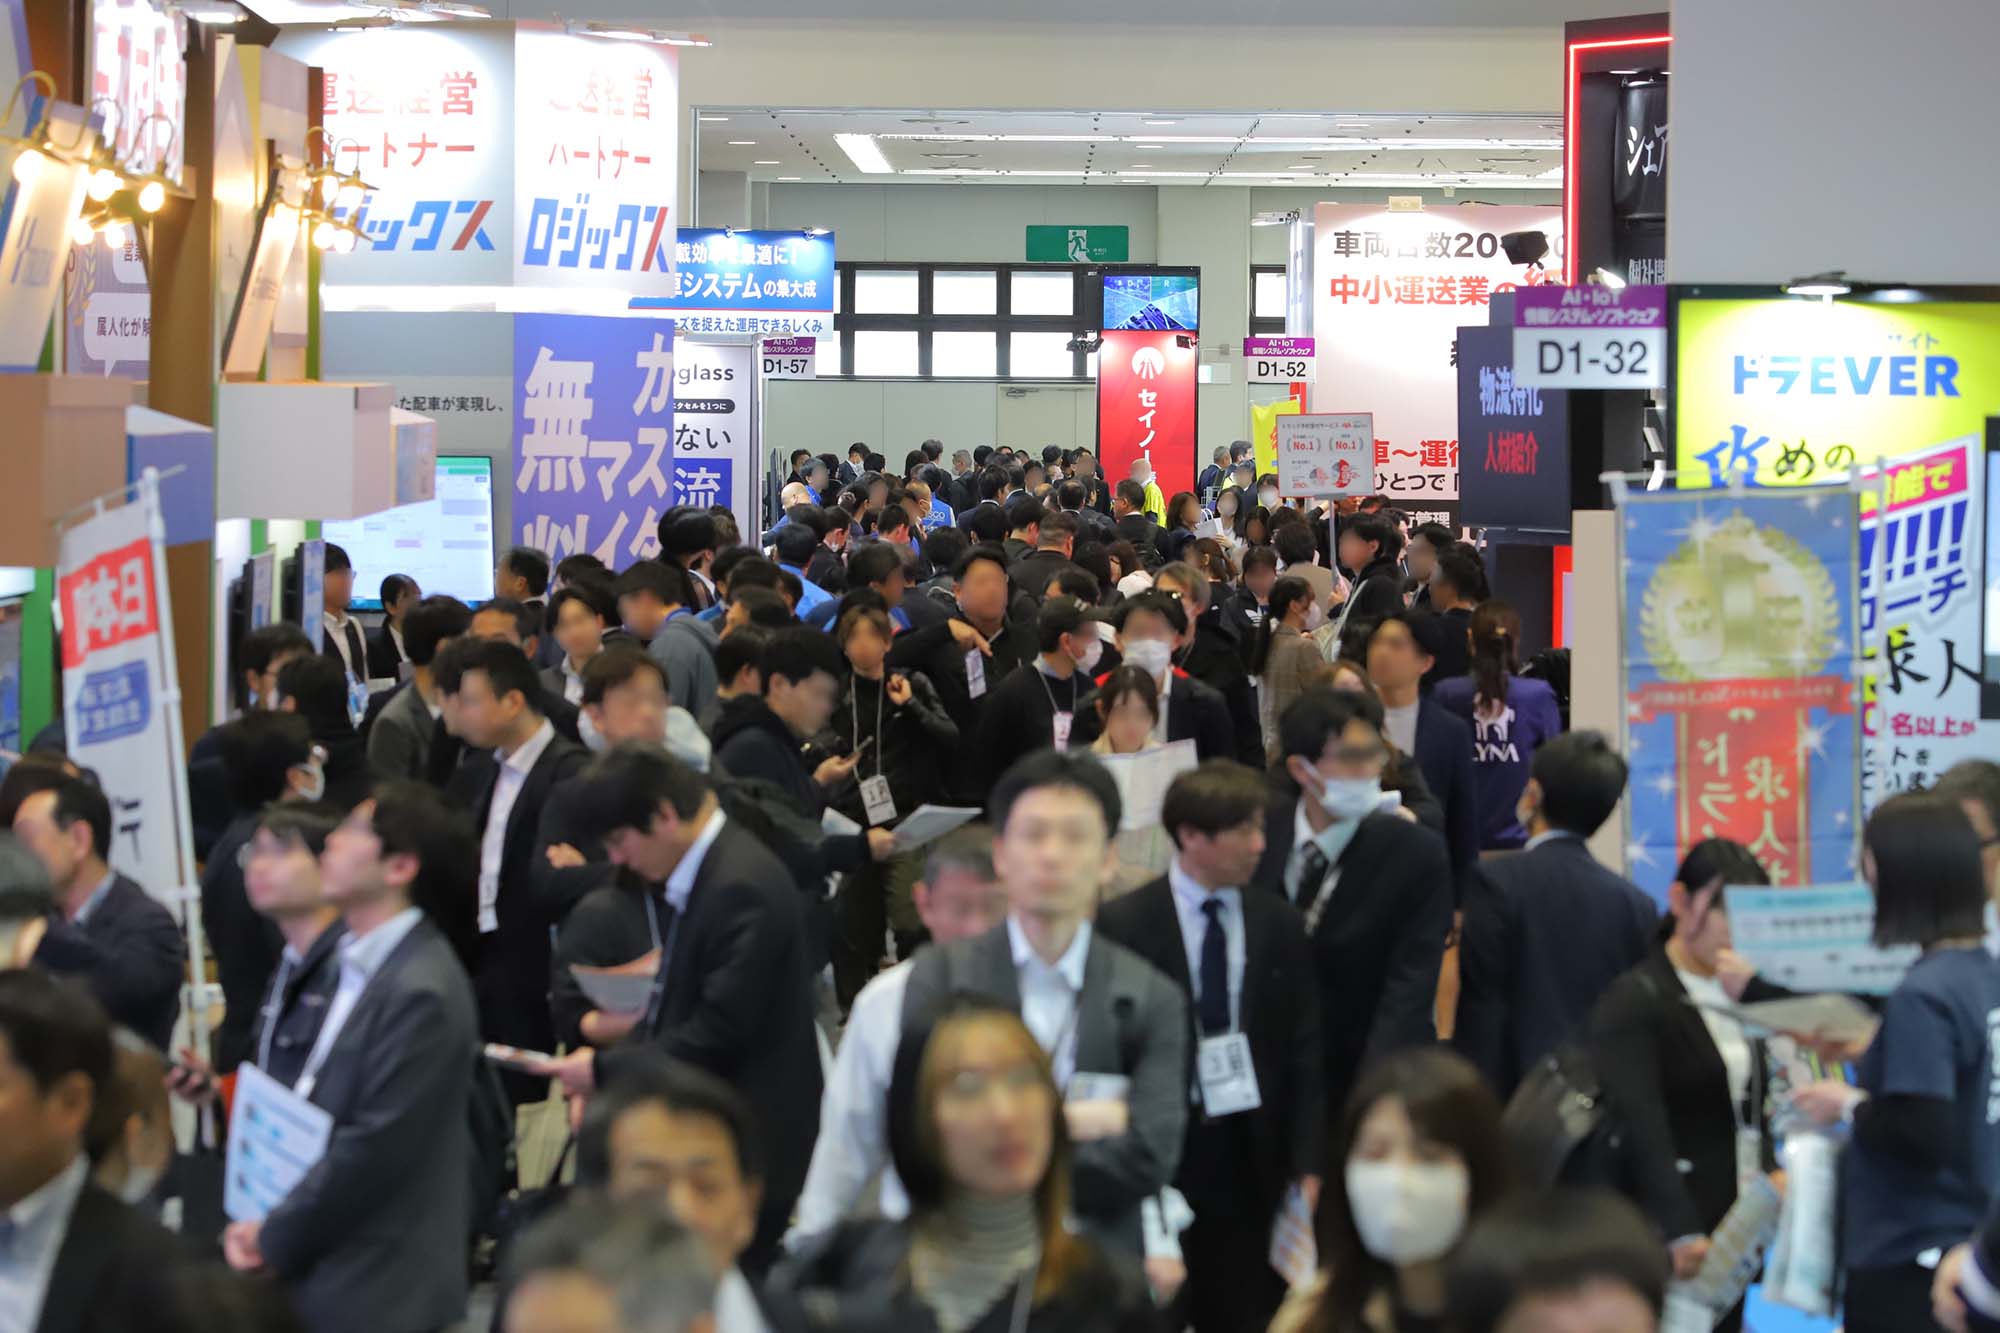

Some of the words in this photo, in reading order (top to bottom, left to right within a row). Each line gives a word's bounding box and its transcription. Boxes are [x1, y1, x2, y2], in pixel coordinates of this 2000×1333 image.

[323, 131, 475, 168] ートナー
[323, 195, 496, 252] ジックス
[523, 193, 670, 273] ロジックス
[674, 317, 823, 333] ズを捉えた運用できるしくみ
[763, 359, 808, 374] D1-57
[1258, 361, 1306, 377] D1-52
[1539, 341, 1648, 374] D1-32
[675, 363, 734, 384] glass
[1733, 355, 1961, 397] ドラEVER
[675, 423, 731, 450] ない
[1293, 441, 1314, 450] No.1
[1336, 441, 1356, 450] No.1
